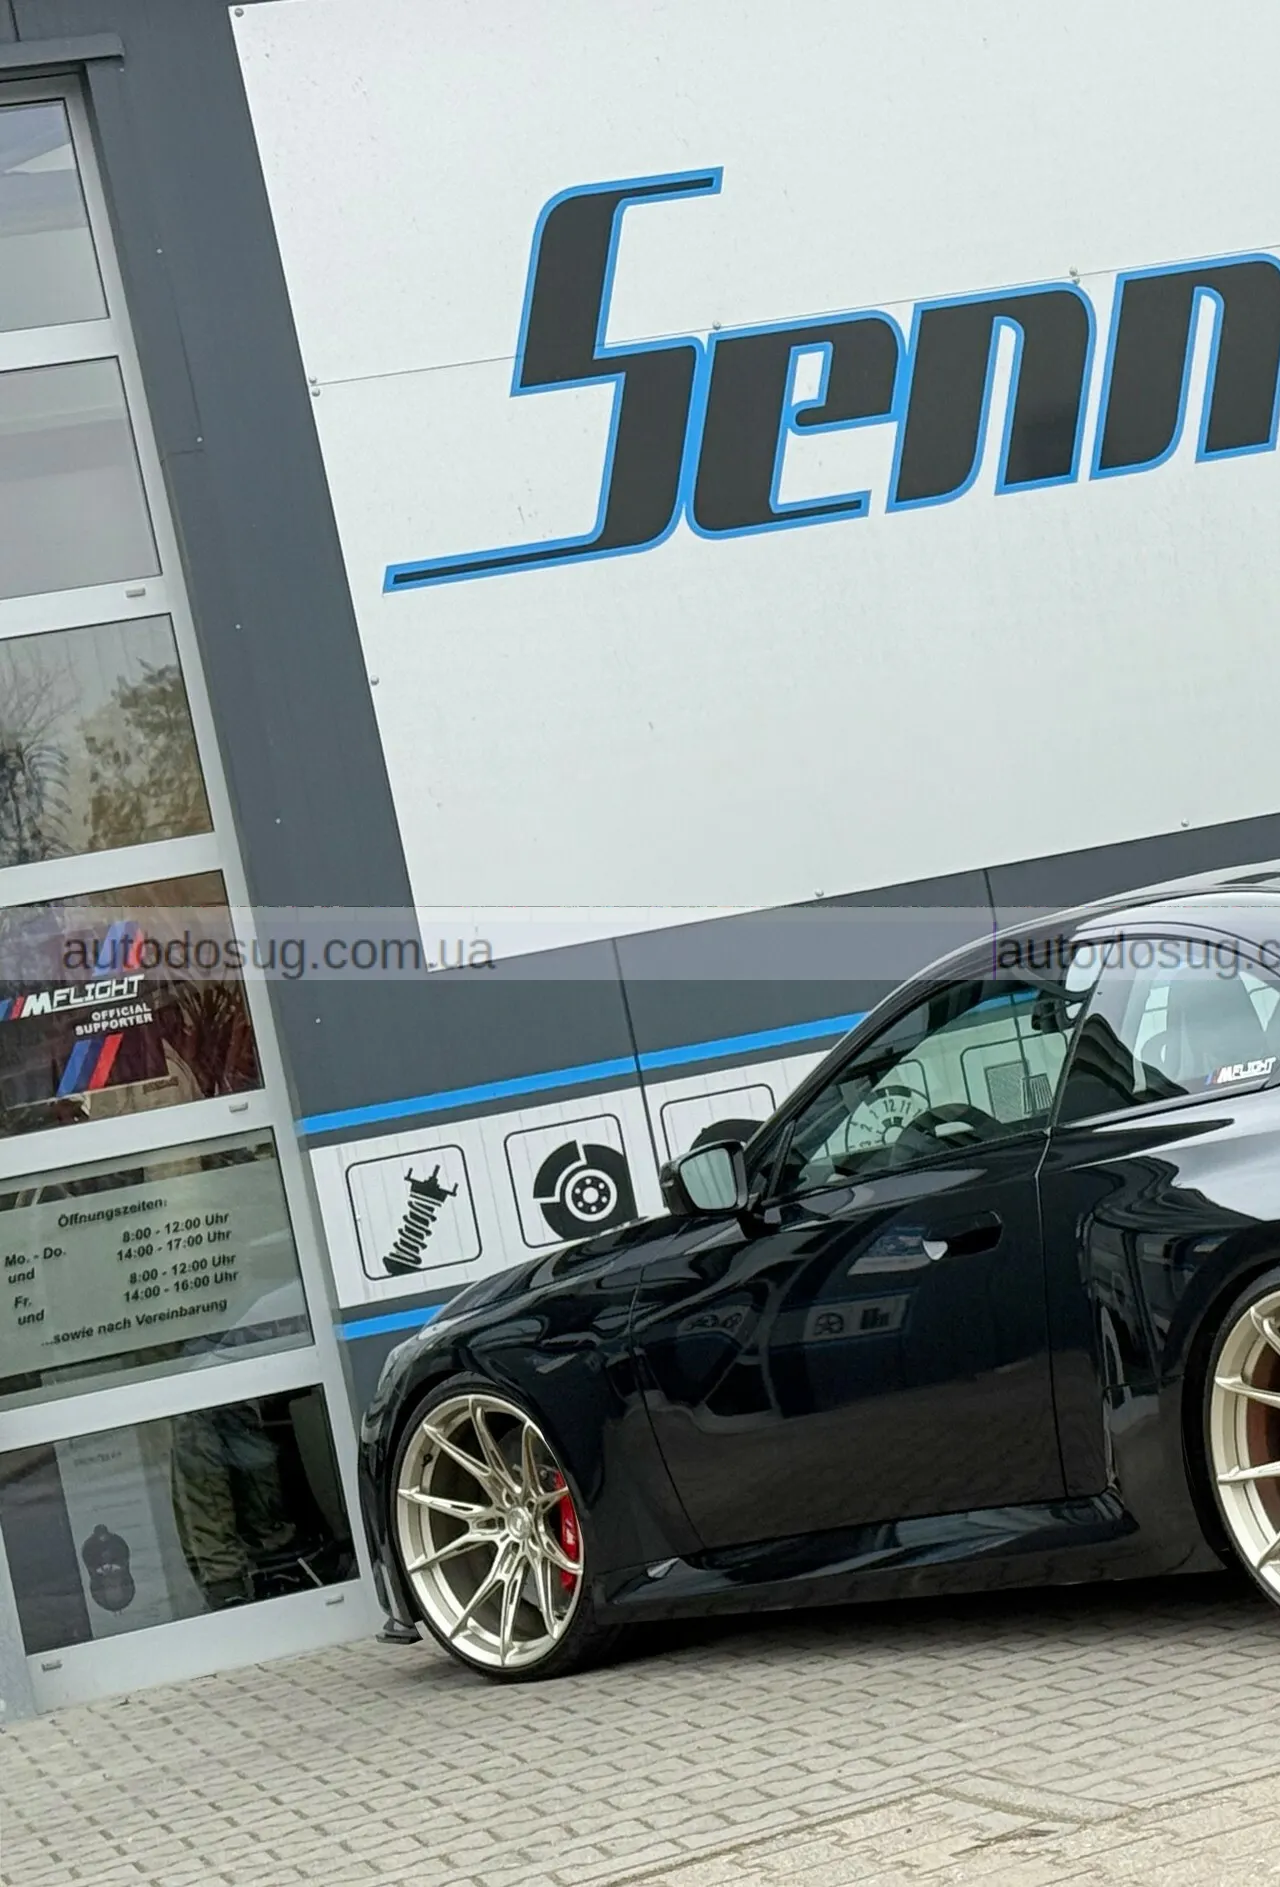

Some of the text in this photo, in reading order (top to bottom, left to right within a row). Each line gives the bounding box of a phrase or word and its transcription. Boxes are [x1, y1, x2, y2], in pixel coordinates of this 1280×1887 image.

[75, 1012, 153, 1036] SUPPORTER
[91, 1002, 152, 1021] OFFICIAL
[883, 1098, 897, 1113] 12
[58, 1198, 168, 1228] Öffnungszeiten:
[5, 1254, 31, 1267] Mo.
[43, 1246, 67, 1260] Do.
[122, 1226, 152, 1243] 8:00
[164, 1216, 201, 1235] 12:00
[204, 1212, 230, 1226] Uhr
[8, 1267, 35, 1284] und
[116, 1243, 154, 1261] 14:00
[166, 1233, 203, 1252] 17:00
[207, 1229, 232, 1243] Uhr
[14, 1295, 32, 1309] Fr.
[129, 1268, 159, 1285] 8:00
[171, 1258, 208, 1276] 12:00
[212, 1253, 237, 1267] Uhr
[18, 1309, 45, 1326] und
[123, 1284, 161, 1302] 14:00
[173, 1274, 210, 1293] 16:00
[214, 1270, 239, 1285] Uhr
[98, 1317, 132, 1335] nach
[135, 1298, 228, 1326] Vereinbarung
